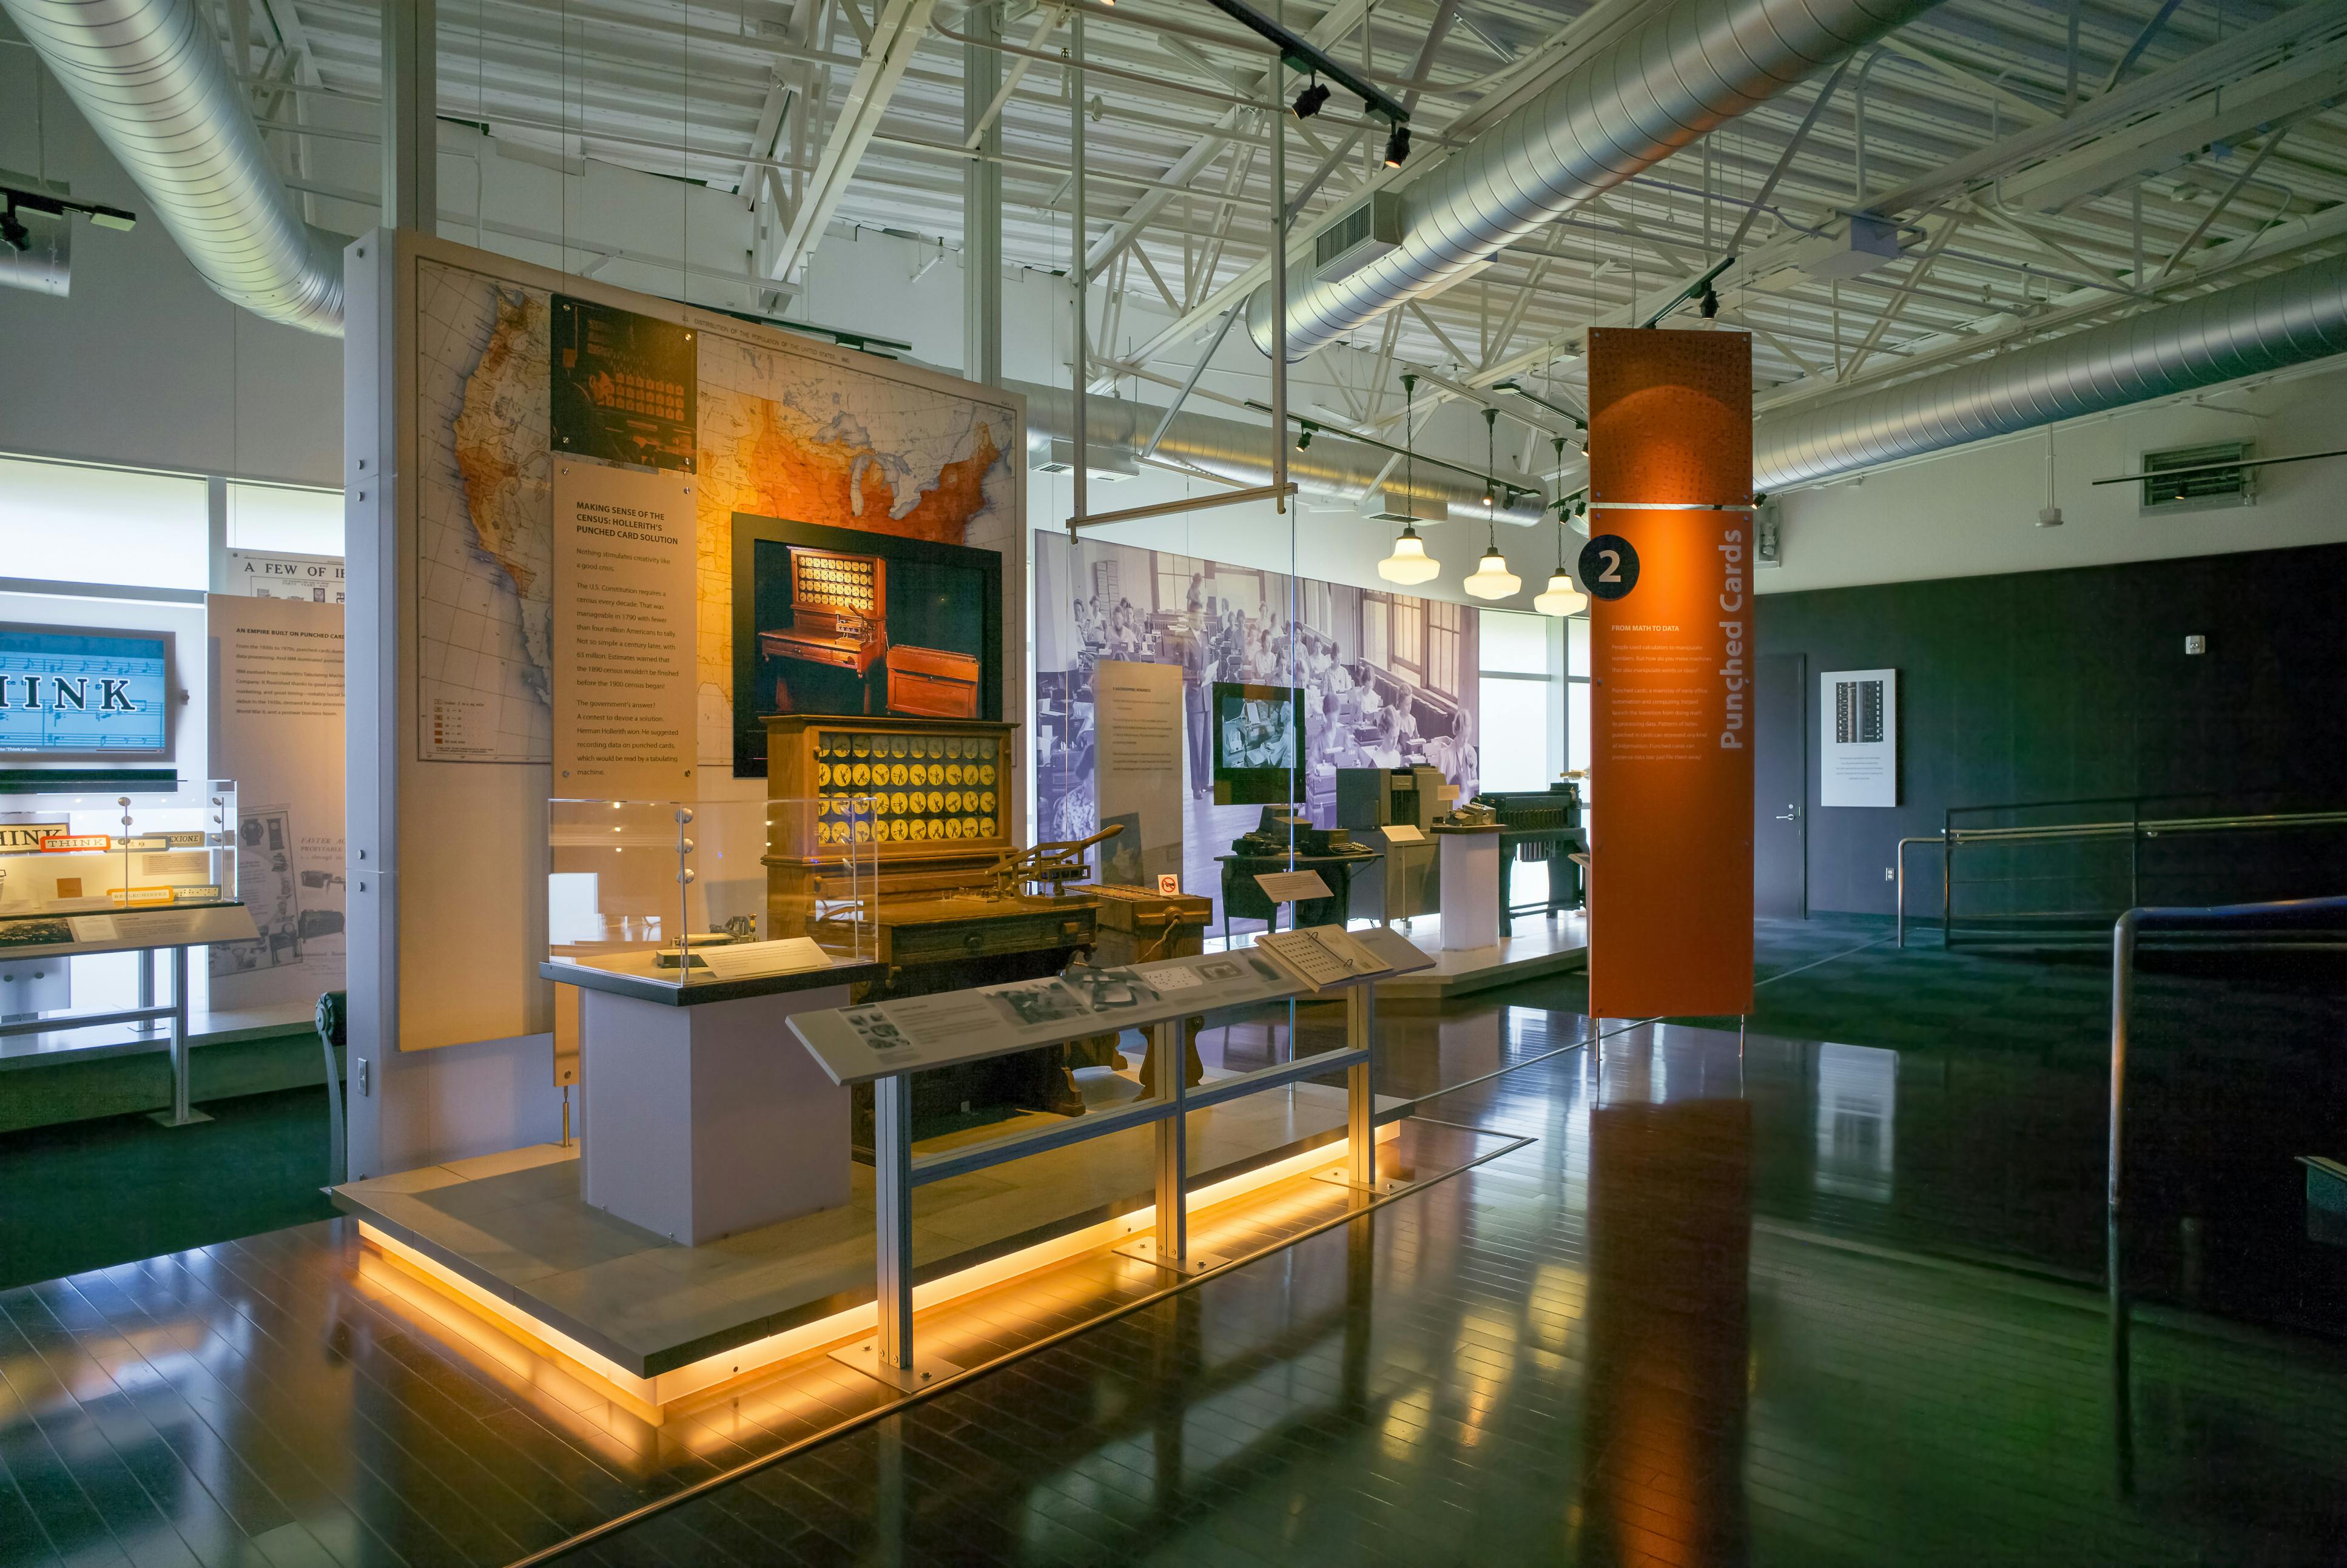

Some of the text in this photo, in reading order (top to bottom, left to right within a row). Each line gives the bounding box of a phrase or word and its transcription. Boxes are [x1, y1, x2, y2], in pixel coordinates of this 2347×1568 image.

[694, 318, 729, 332] DISTRIBUTION
[752, 334, 780, 346] POPULATION
[801, 346, 818, 355] UNITED
[576, 502, 664, 520] MAKING SENSE OF THE
[576, 514, 662, 531] CENSUS: HOLLERITH'S
[576, 525, 678, 545] PUNCHED CARD SOLUTION
[576, 548, 601, 557] Nothing
[602, 551, 632, 560] stimulates
[633, 556, 659, 564] creativity
[244, 562, 255, 572] A
[266, 564, 297, 574] FEW
[308, 567, 326, 576] OF
[1598, 550, 1621, 582] 2
[601, 585, 638, 594] Constitution
[1718, 530, 1743, 749] Punched Cards
